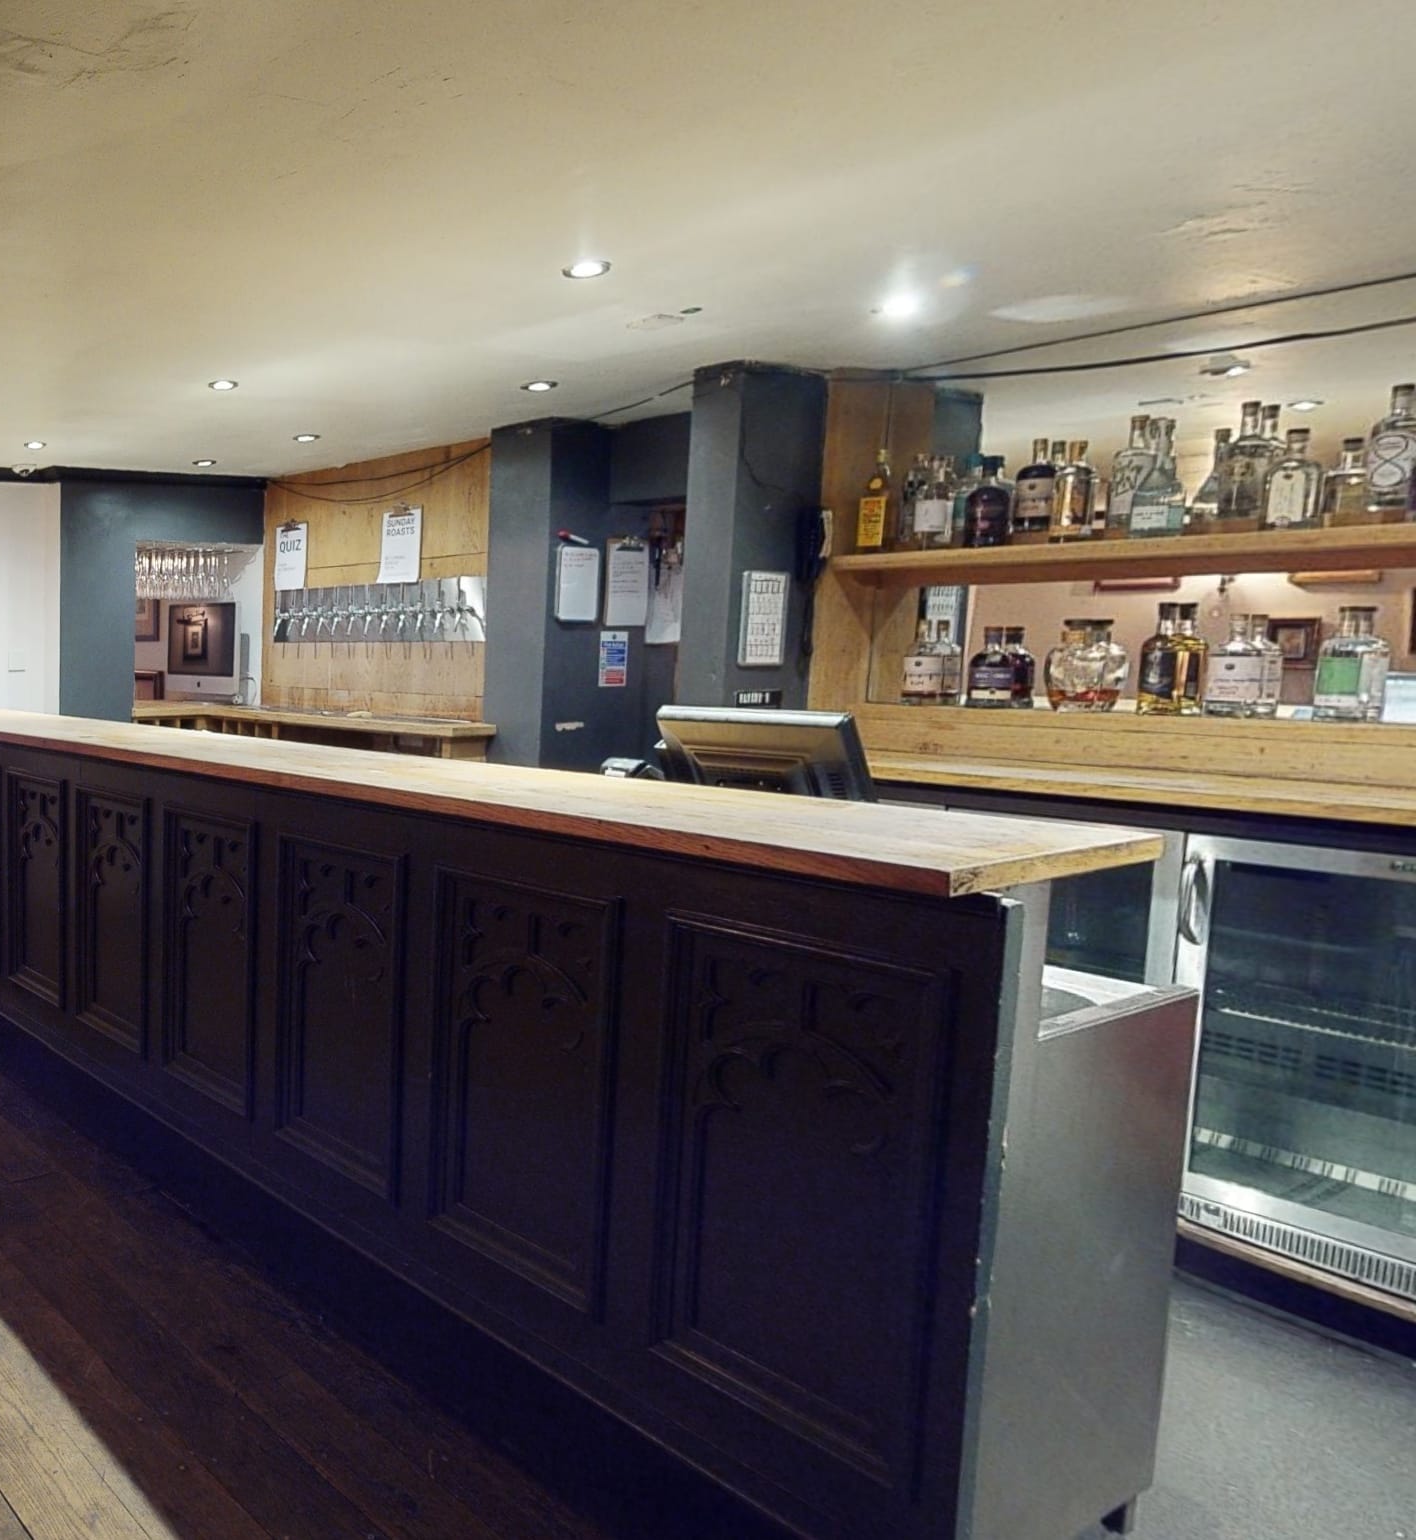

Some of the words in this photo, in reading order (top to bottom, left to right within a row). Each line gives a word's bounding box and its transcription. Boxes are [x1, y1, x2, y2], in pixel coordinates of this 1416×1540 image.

[386, 518, 416, 528] SUNDAY
[386, 527, 415, 537] ROASTS
[279, 539, 302, 553] QUIZ
